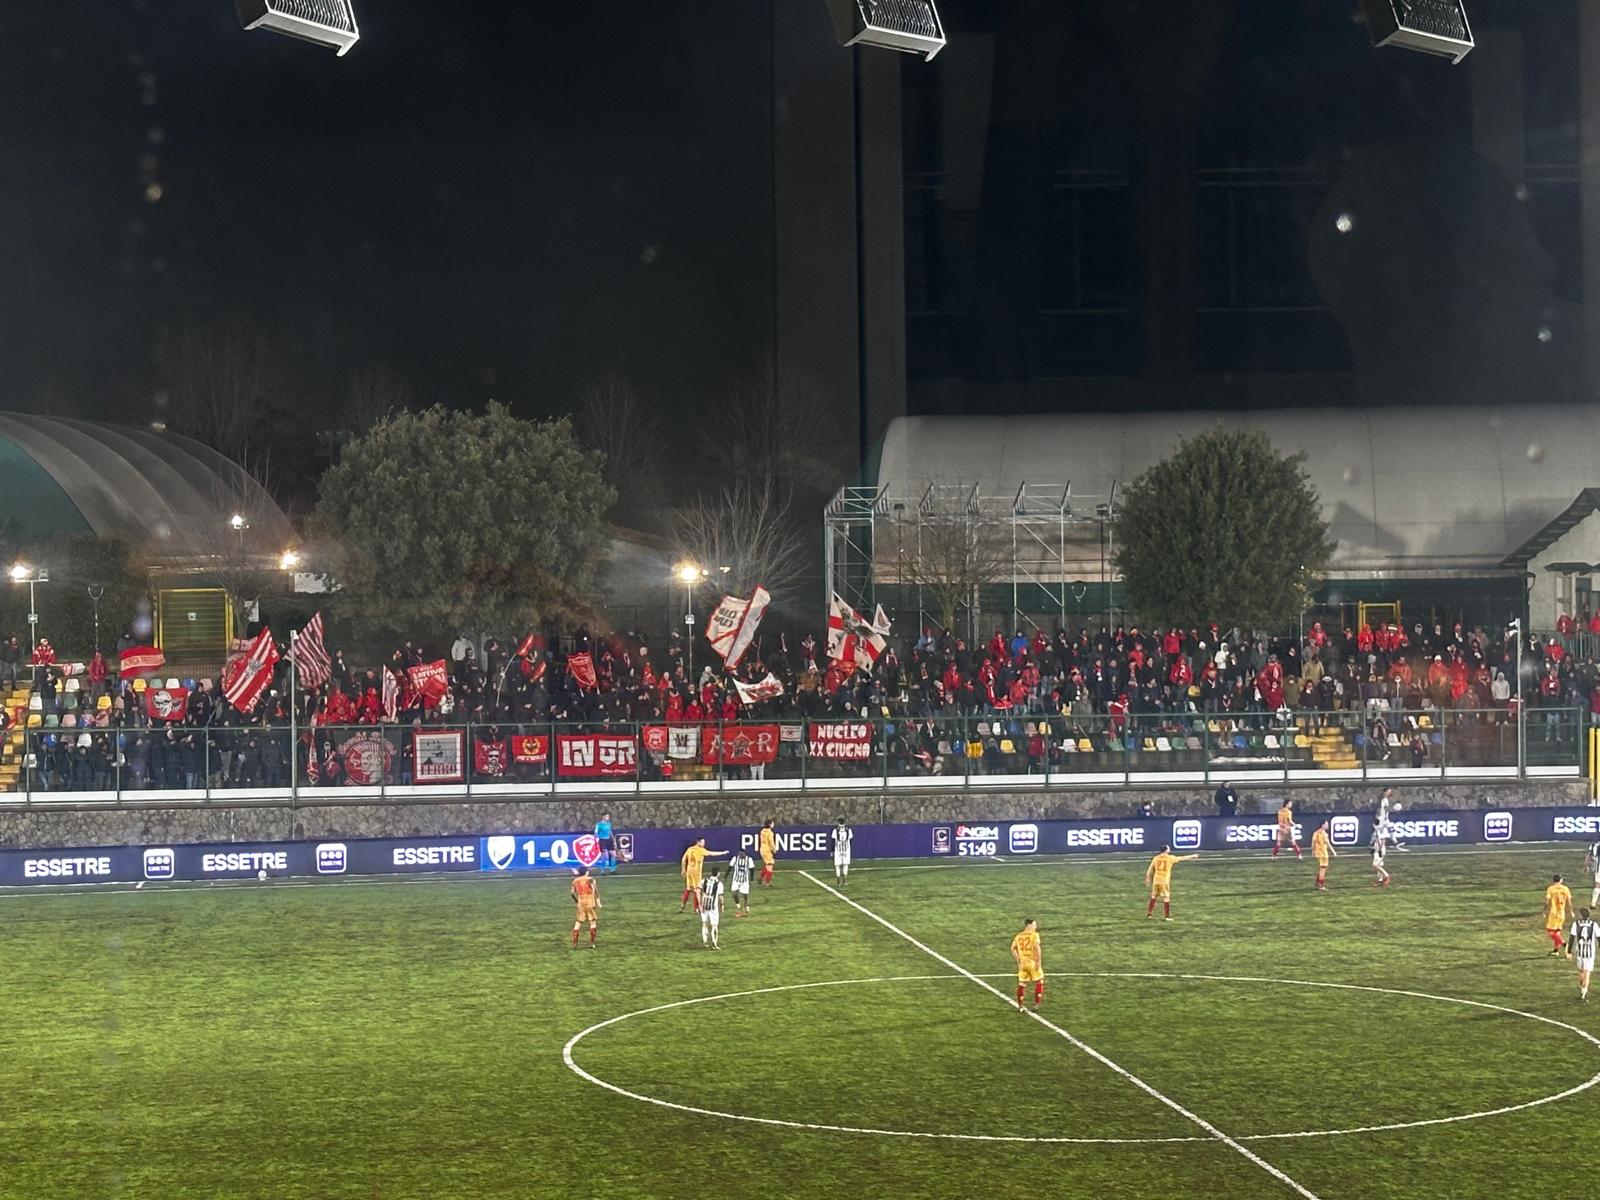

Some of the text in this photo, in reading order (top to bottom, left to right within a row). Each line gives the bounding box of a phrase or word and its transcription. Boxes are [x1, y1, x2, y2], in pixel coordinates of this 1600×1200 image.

[817, 724, 867, 739] NUCLEO
[741, 833, 827, 852] PINESE
[1067, 828, 1144, 846] ESSETRE
[1226, 824, 1302, 842] ESSETE
[393, 846, 475, 865] ESSETRE
[522, 839, 569, 865] 1-0
[958, 841, 996, 856] 51:49
[24, 857, 111, 878] ESSETRE
[203, 852, 287, 871] ESSETRE
